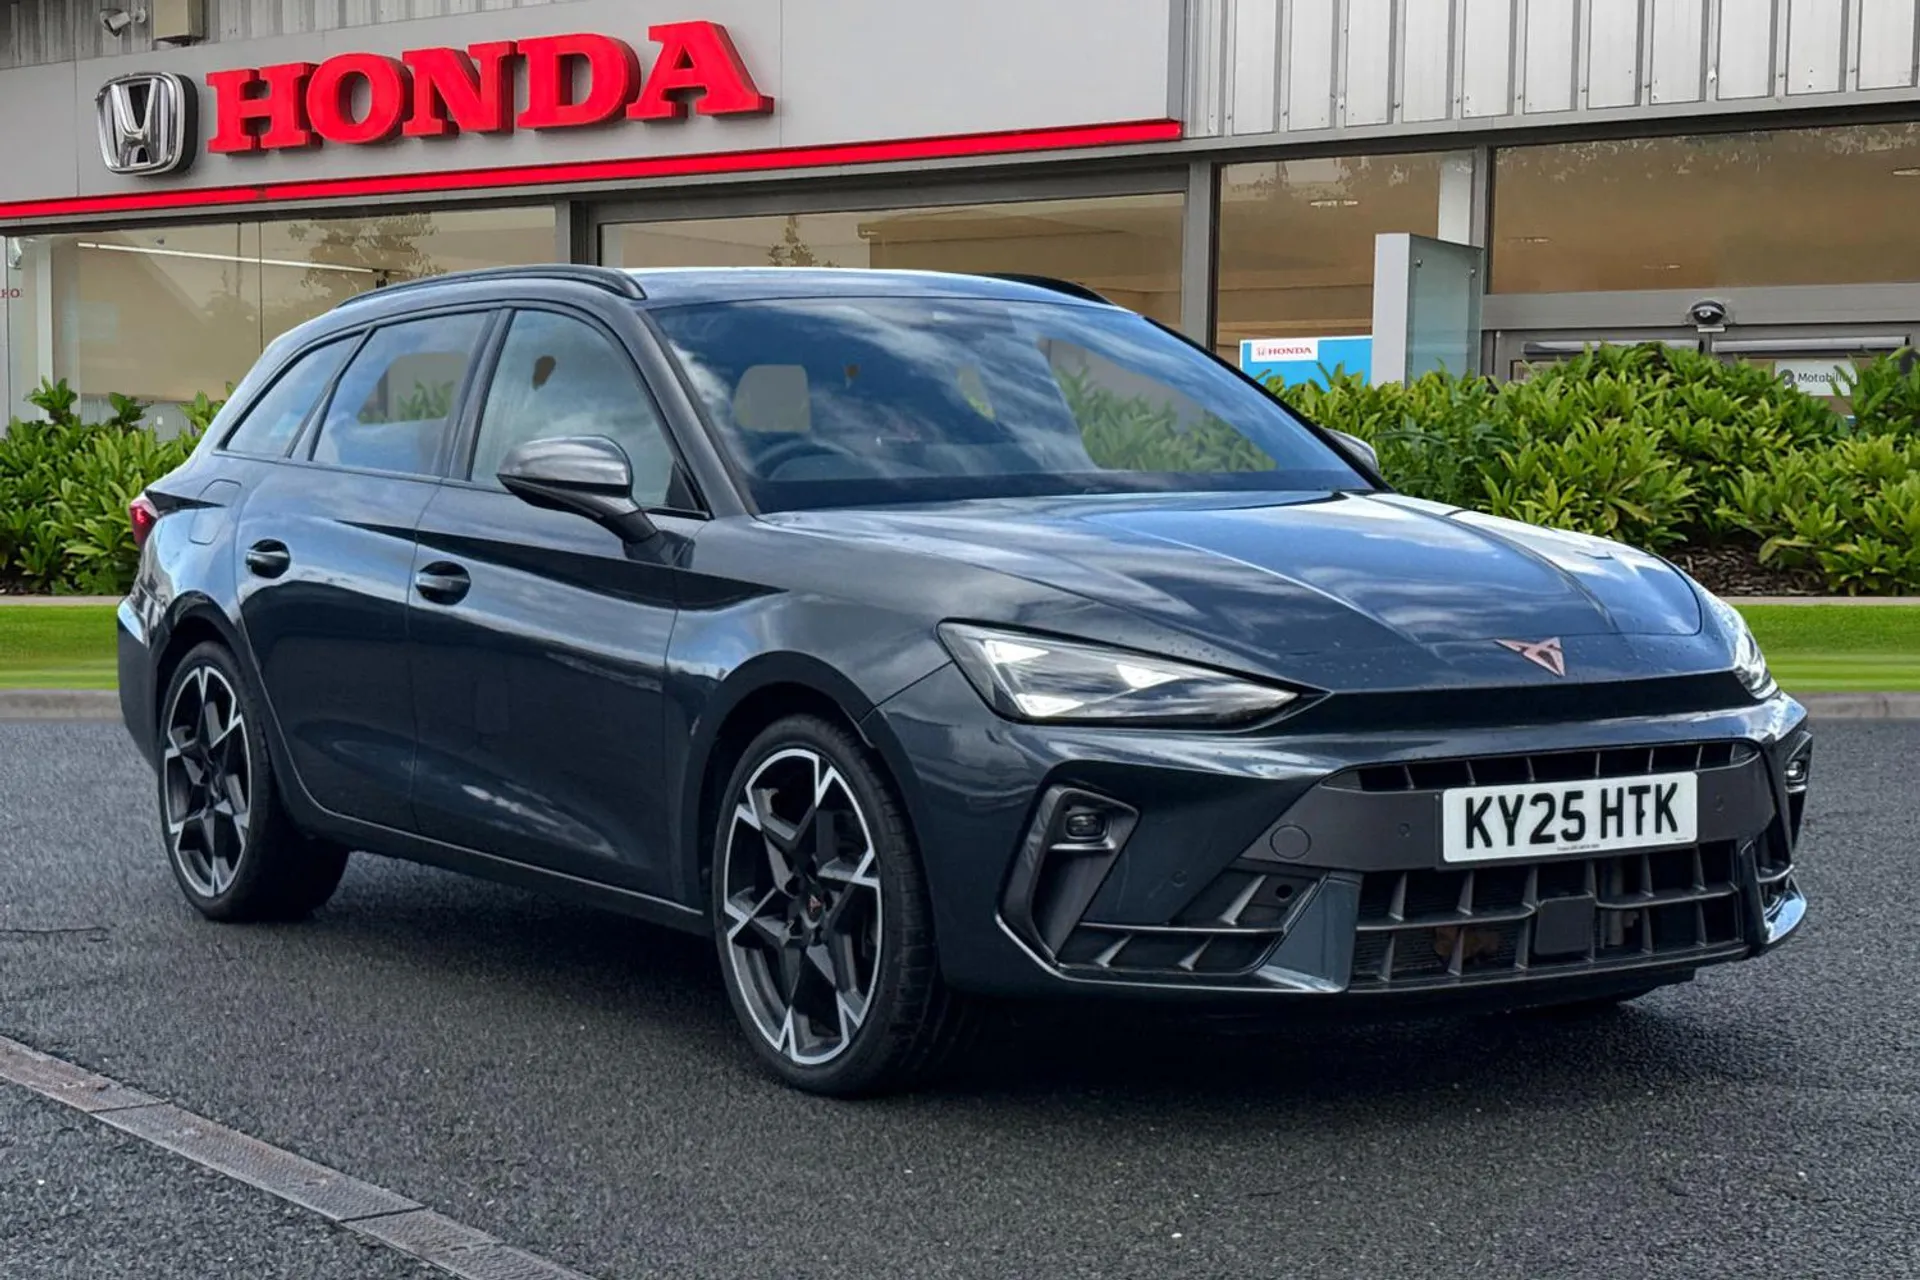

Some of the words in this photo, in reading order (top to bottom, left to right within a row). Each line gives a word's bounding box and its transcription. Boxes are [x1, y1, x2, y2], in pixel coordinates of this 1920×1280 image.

[206, 20, 774, 154] HONDA
[1, 288, 23, 298] HO
[1268, 347, 1313, 355] HONDA
[1798, 372, 1853, 384] Motabili
[1465, 791, 1586, 849] KY25
[1600, 782, 1679, 839] HTK
